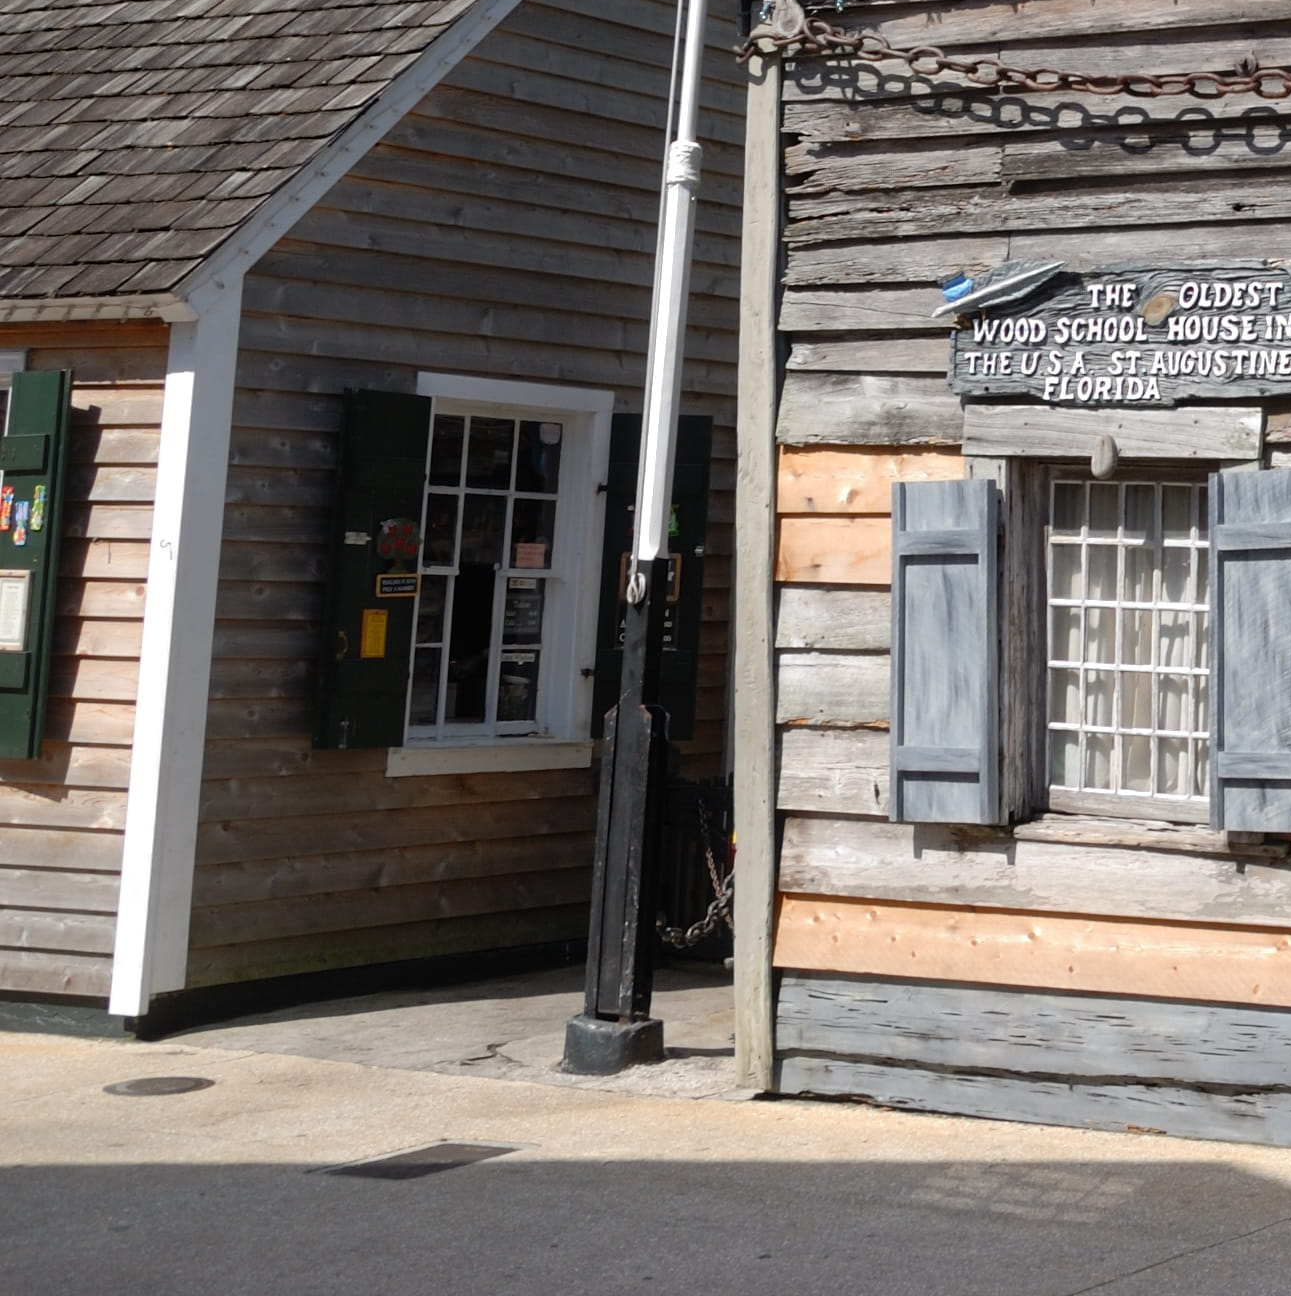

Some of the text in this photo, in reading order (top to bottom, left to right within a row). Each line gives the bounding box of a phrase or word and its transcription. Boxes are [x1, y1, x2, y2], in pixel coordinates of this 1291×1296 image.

[1087, 281, 1284, 311] THE OLDEST
[972, 317, 1048, 345] WOOD
[1053, 315, 1148, 345] SCHOOL
[1167, 314, 1258, 342] HOUSE
[964, 352, 1013, 375] THE
[1042, 375, 1162, 402] FLORIDA
